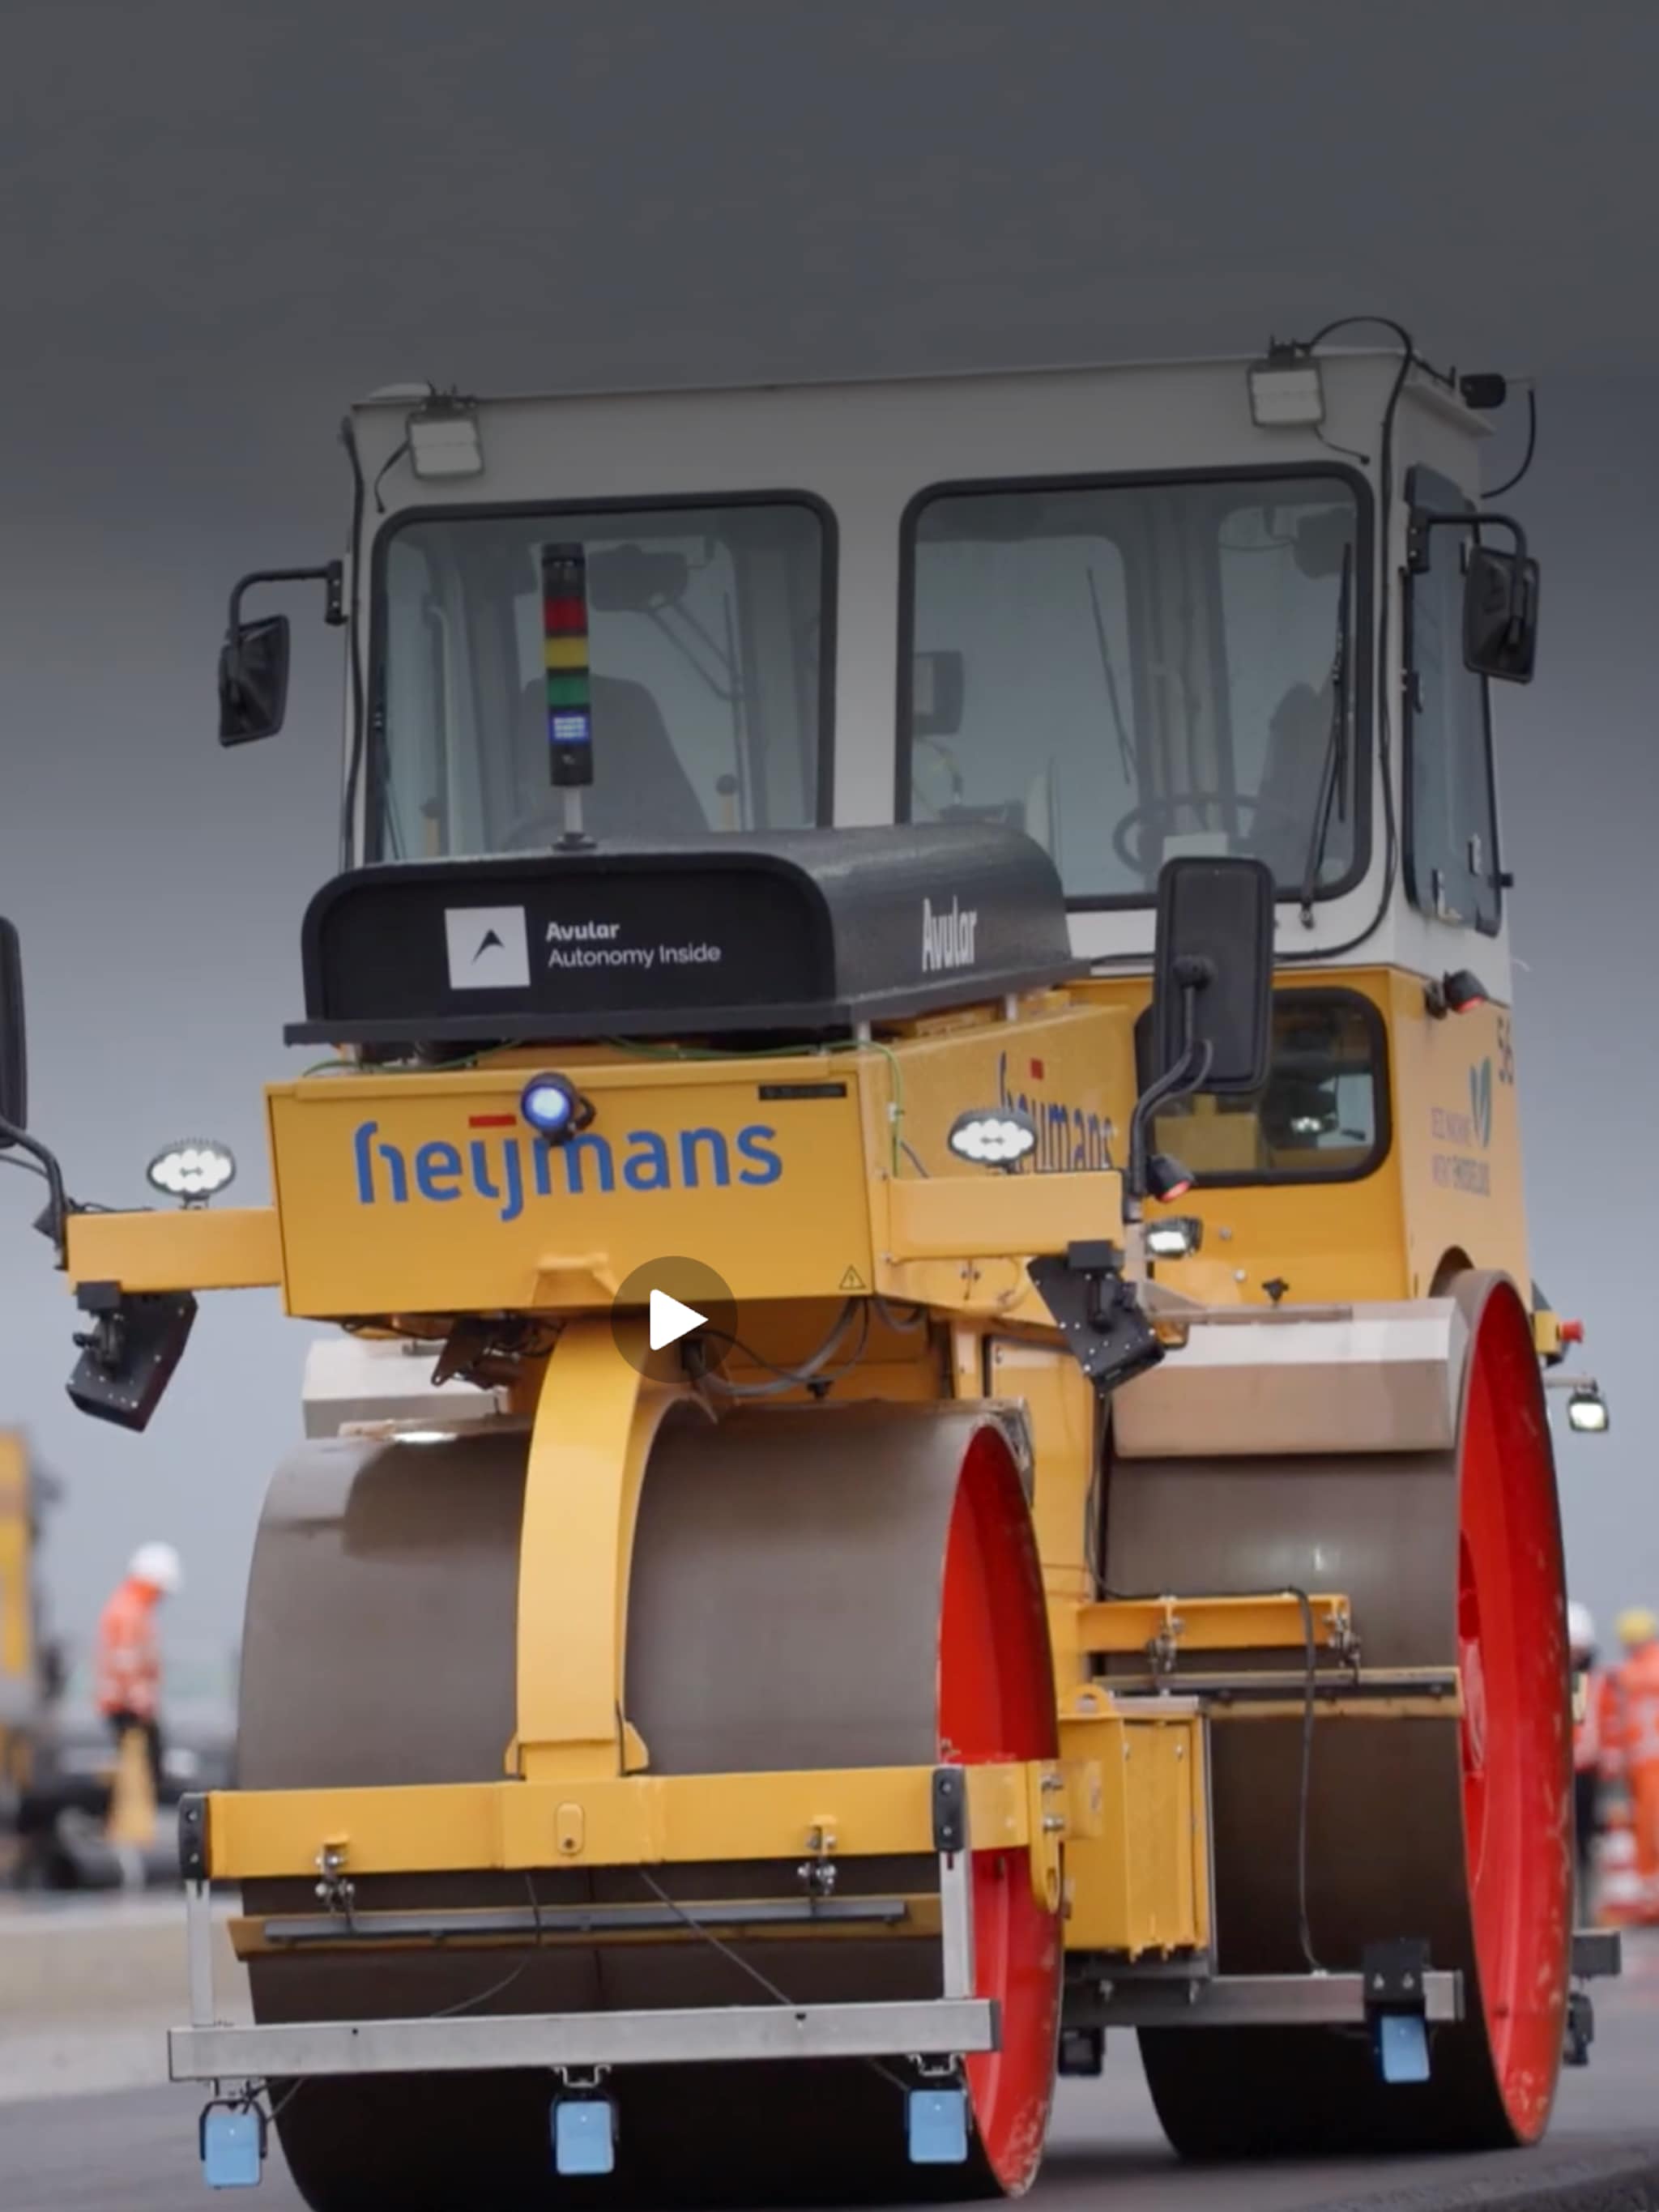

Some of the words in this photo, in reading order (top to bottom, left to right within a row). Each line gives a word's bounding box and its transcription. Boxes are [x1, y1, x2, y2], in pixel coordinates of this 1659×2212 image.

[546, 920, 620, 942] Avular
[548, 948, 654, 969] Autonomy
[659, 942, 721, 964] Inside
[923, 895, 977, 971] Avular
[354, 1115, 783, 1222] heijmans
